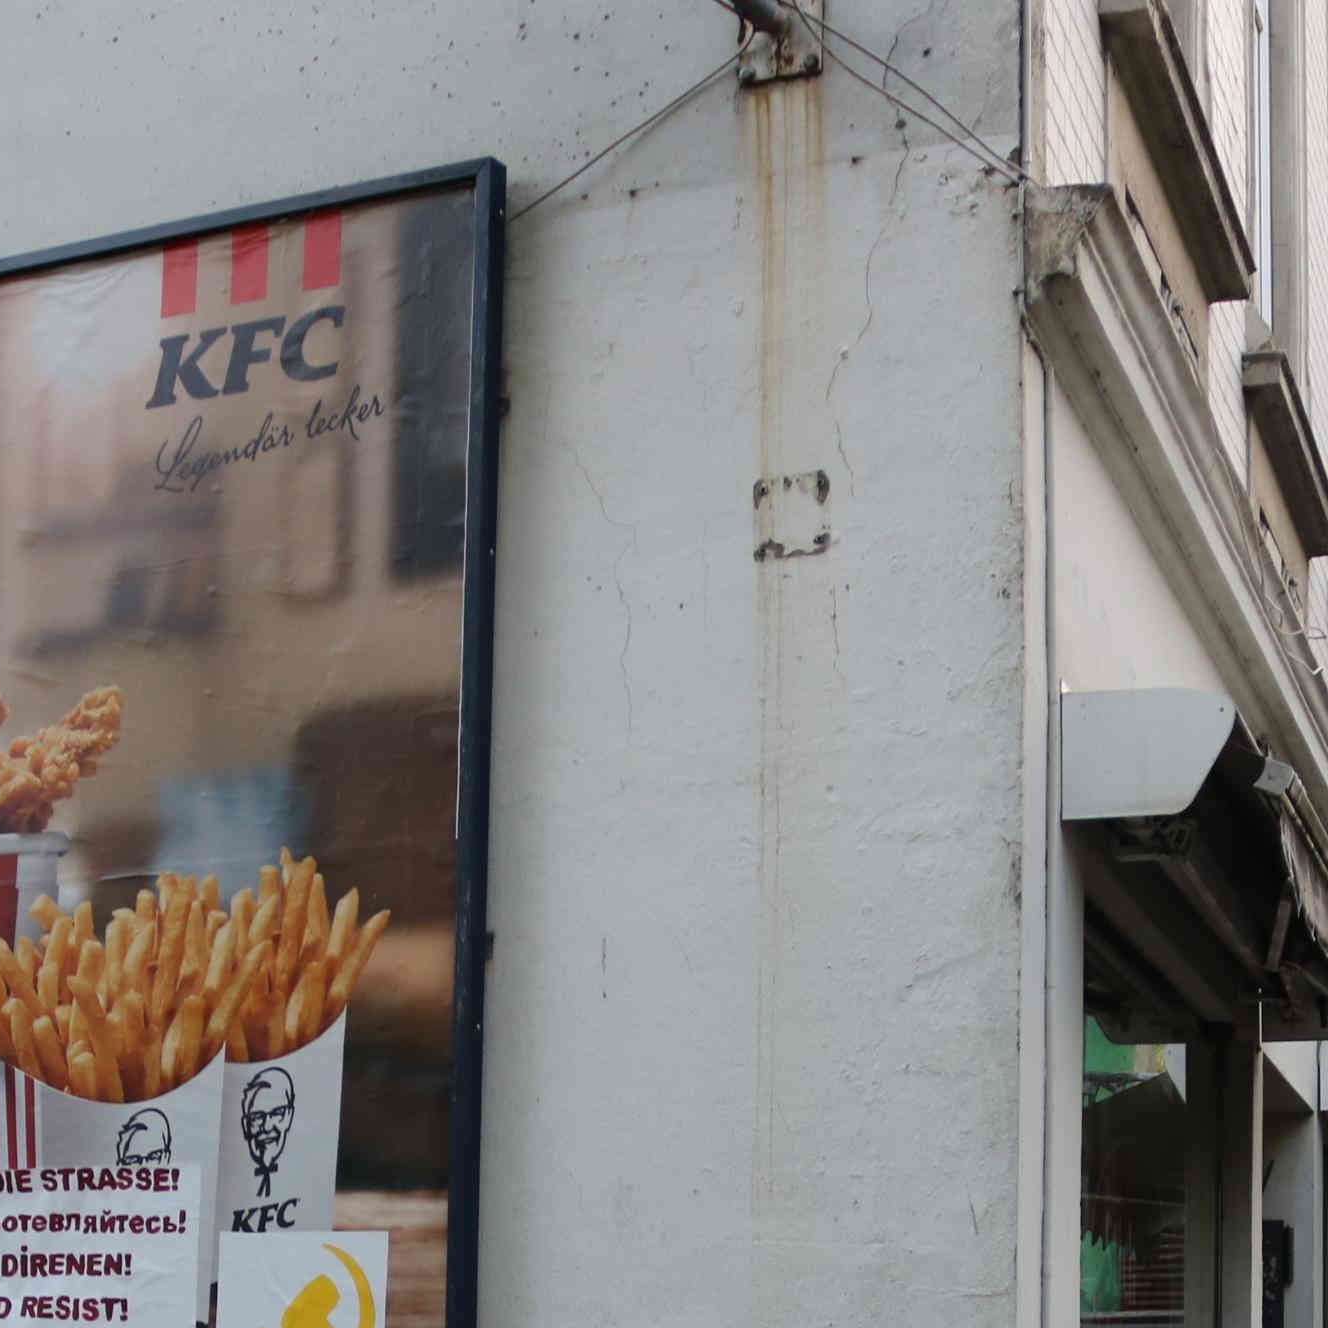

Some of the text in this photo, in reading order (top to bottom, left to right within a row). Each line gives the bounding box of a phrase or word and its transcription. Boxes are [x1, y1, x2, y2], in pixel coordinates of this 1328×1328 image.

[145, 304, 346, 410] KFC
[153, 385, 384, 493] Legendär lecker
[41, 1168, 180, 1192] STRASSE!
[232, 1198, 300, 1232] KFC
[1, 1246, 132, 1278] DİRENEN!
[20, 1296, 128, 1321] RESIST!
